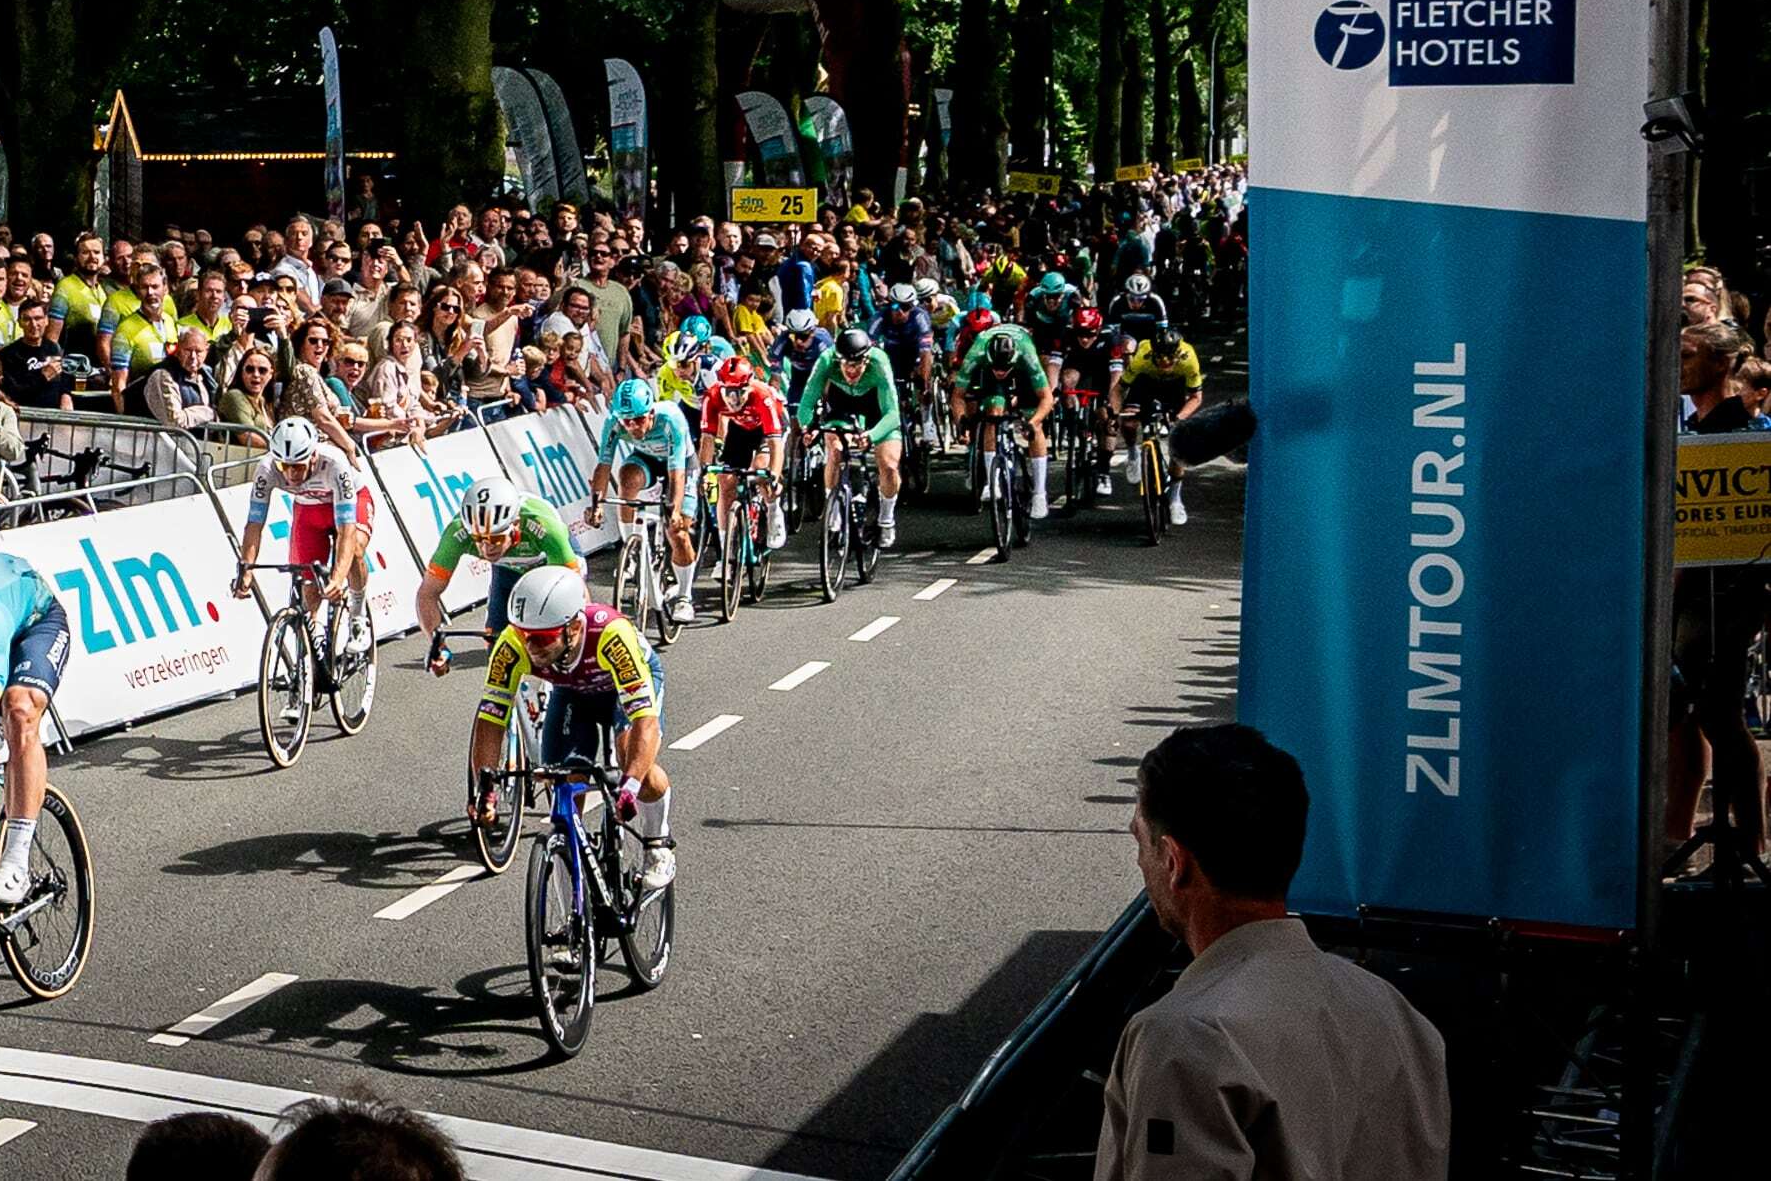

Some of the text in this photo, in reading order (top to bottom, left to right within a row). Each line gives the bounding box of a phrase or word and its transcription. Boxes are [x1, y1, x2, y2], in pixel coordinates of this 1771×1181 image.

[1396, 0, 1555, 29] FLETCHER
[1396, 38, 1522, 67] HOTELS
[780, 195, 804, 215] 25
[1675, 506, 1727, 523] ORES
[1404, 342, 1467, 798] ZLMTOUR.NL
[124, 644, 231, 690] verzekeringen
